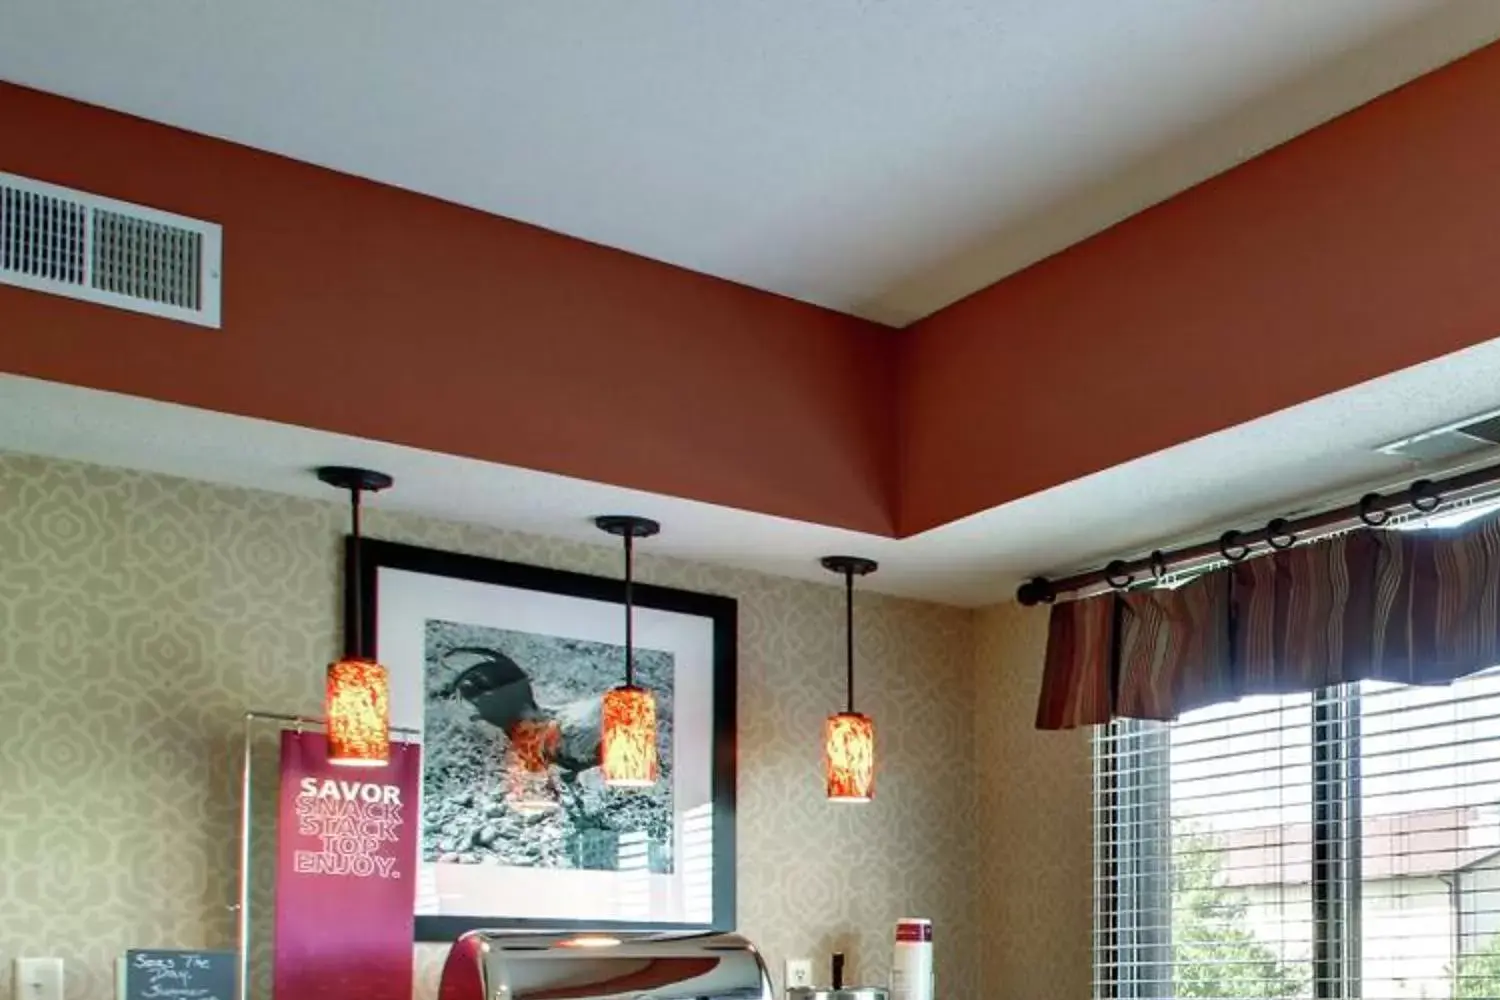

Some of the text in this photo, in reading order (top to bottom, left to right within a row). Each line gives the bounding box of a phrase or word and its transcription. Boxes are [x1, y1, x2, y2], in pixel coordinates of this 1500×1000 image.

[300, 777, 401, 805] SAVOR
[295, 796, 404, 824] SNACK
[298, 814, 399, 842] STACK
[319, 833, 380, 856] TOP
[294, 850, 401, 879] ENJOY.
